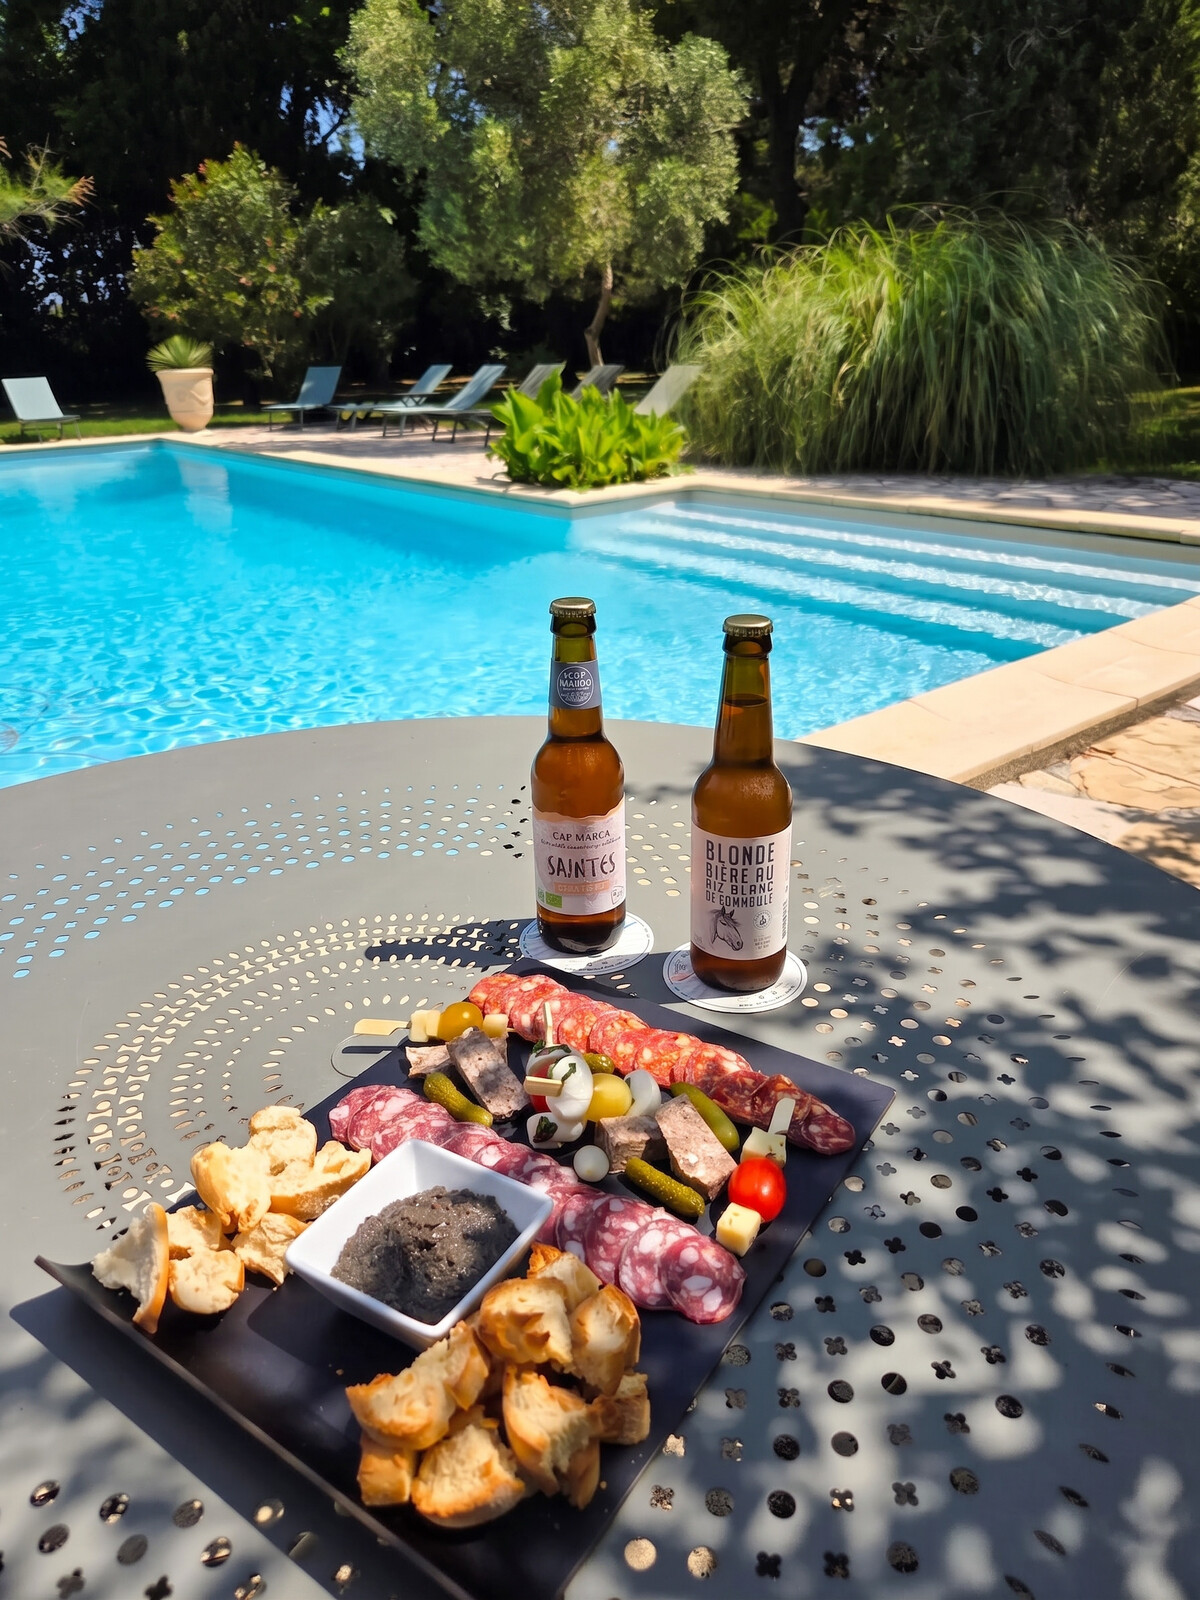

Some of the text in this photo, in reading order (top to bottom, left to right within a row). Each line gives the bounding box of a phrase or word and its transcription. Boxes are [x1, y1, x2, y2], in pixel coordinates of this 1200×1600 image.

[552, 829, 611, 842] CAP MARCA
[706, 839, 775, 866] BLONDE
[547, 851, 616, 879] SAINTES
[705, 862, 774, 884] BIÈRE AU
[705, 889, 716, 904] DE
[730, 881, 774, 896] BLANC
